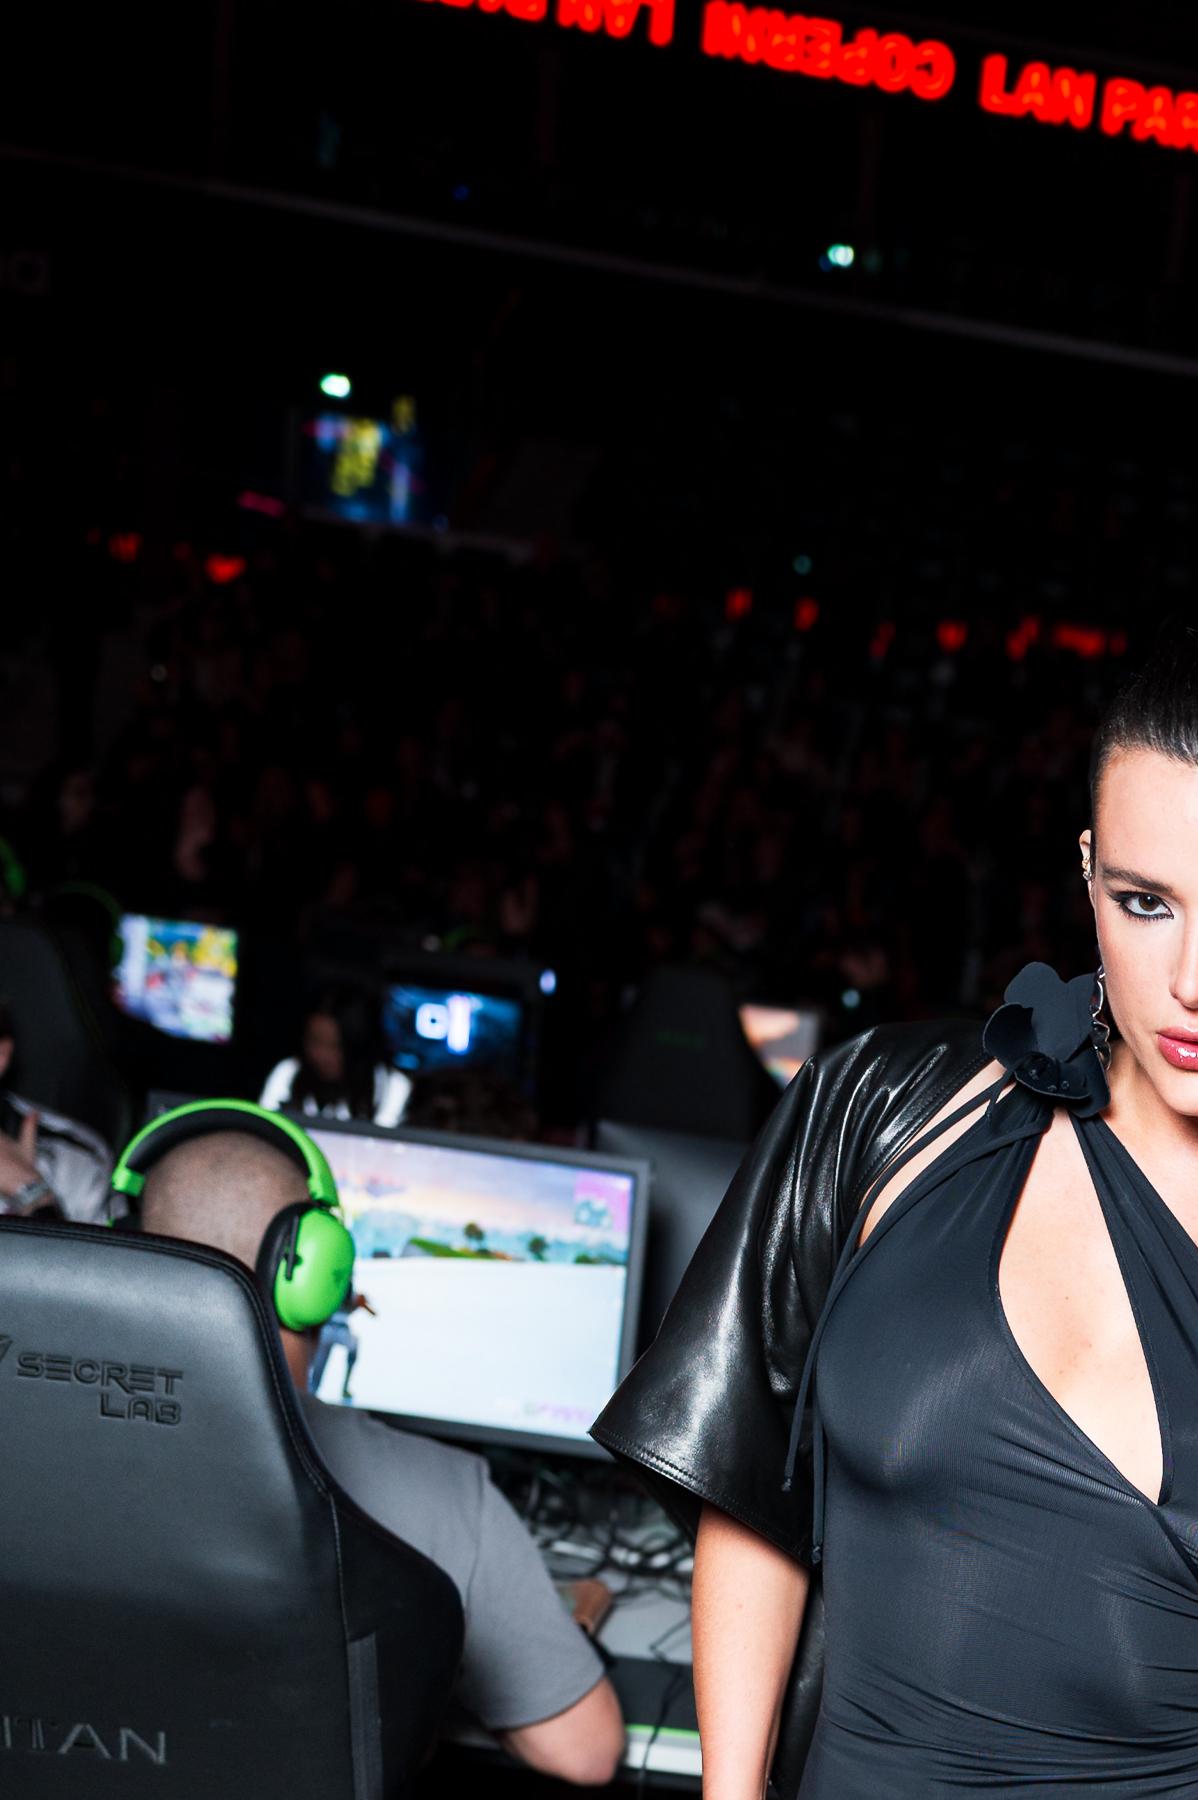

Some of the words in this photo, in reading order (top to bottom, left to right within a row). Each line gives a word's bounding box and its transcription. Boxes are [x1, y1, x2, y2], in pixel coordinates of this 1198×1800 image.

[980, 53, 1097, 130] LAN
[17, 1352, 184, 1395] SECRET
[100, 1392, 182, 1426] LAB
